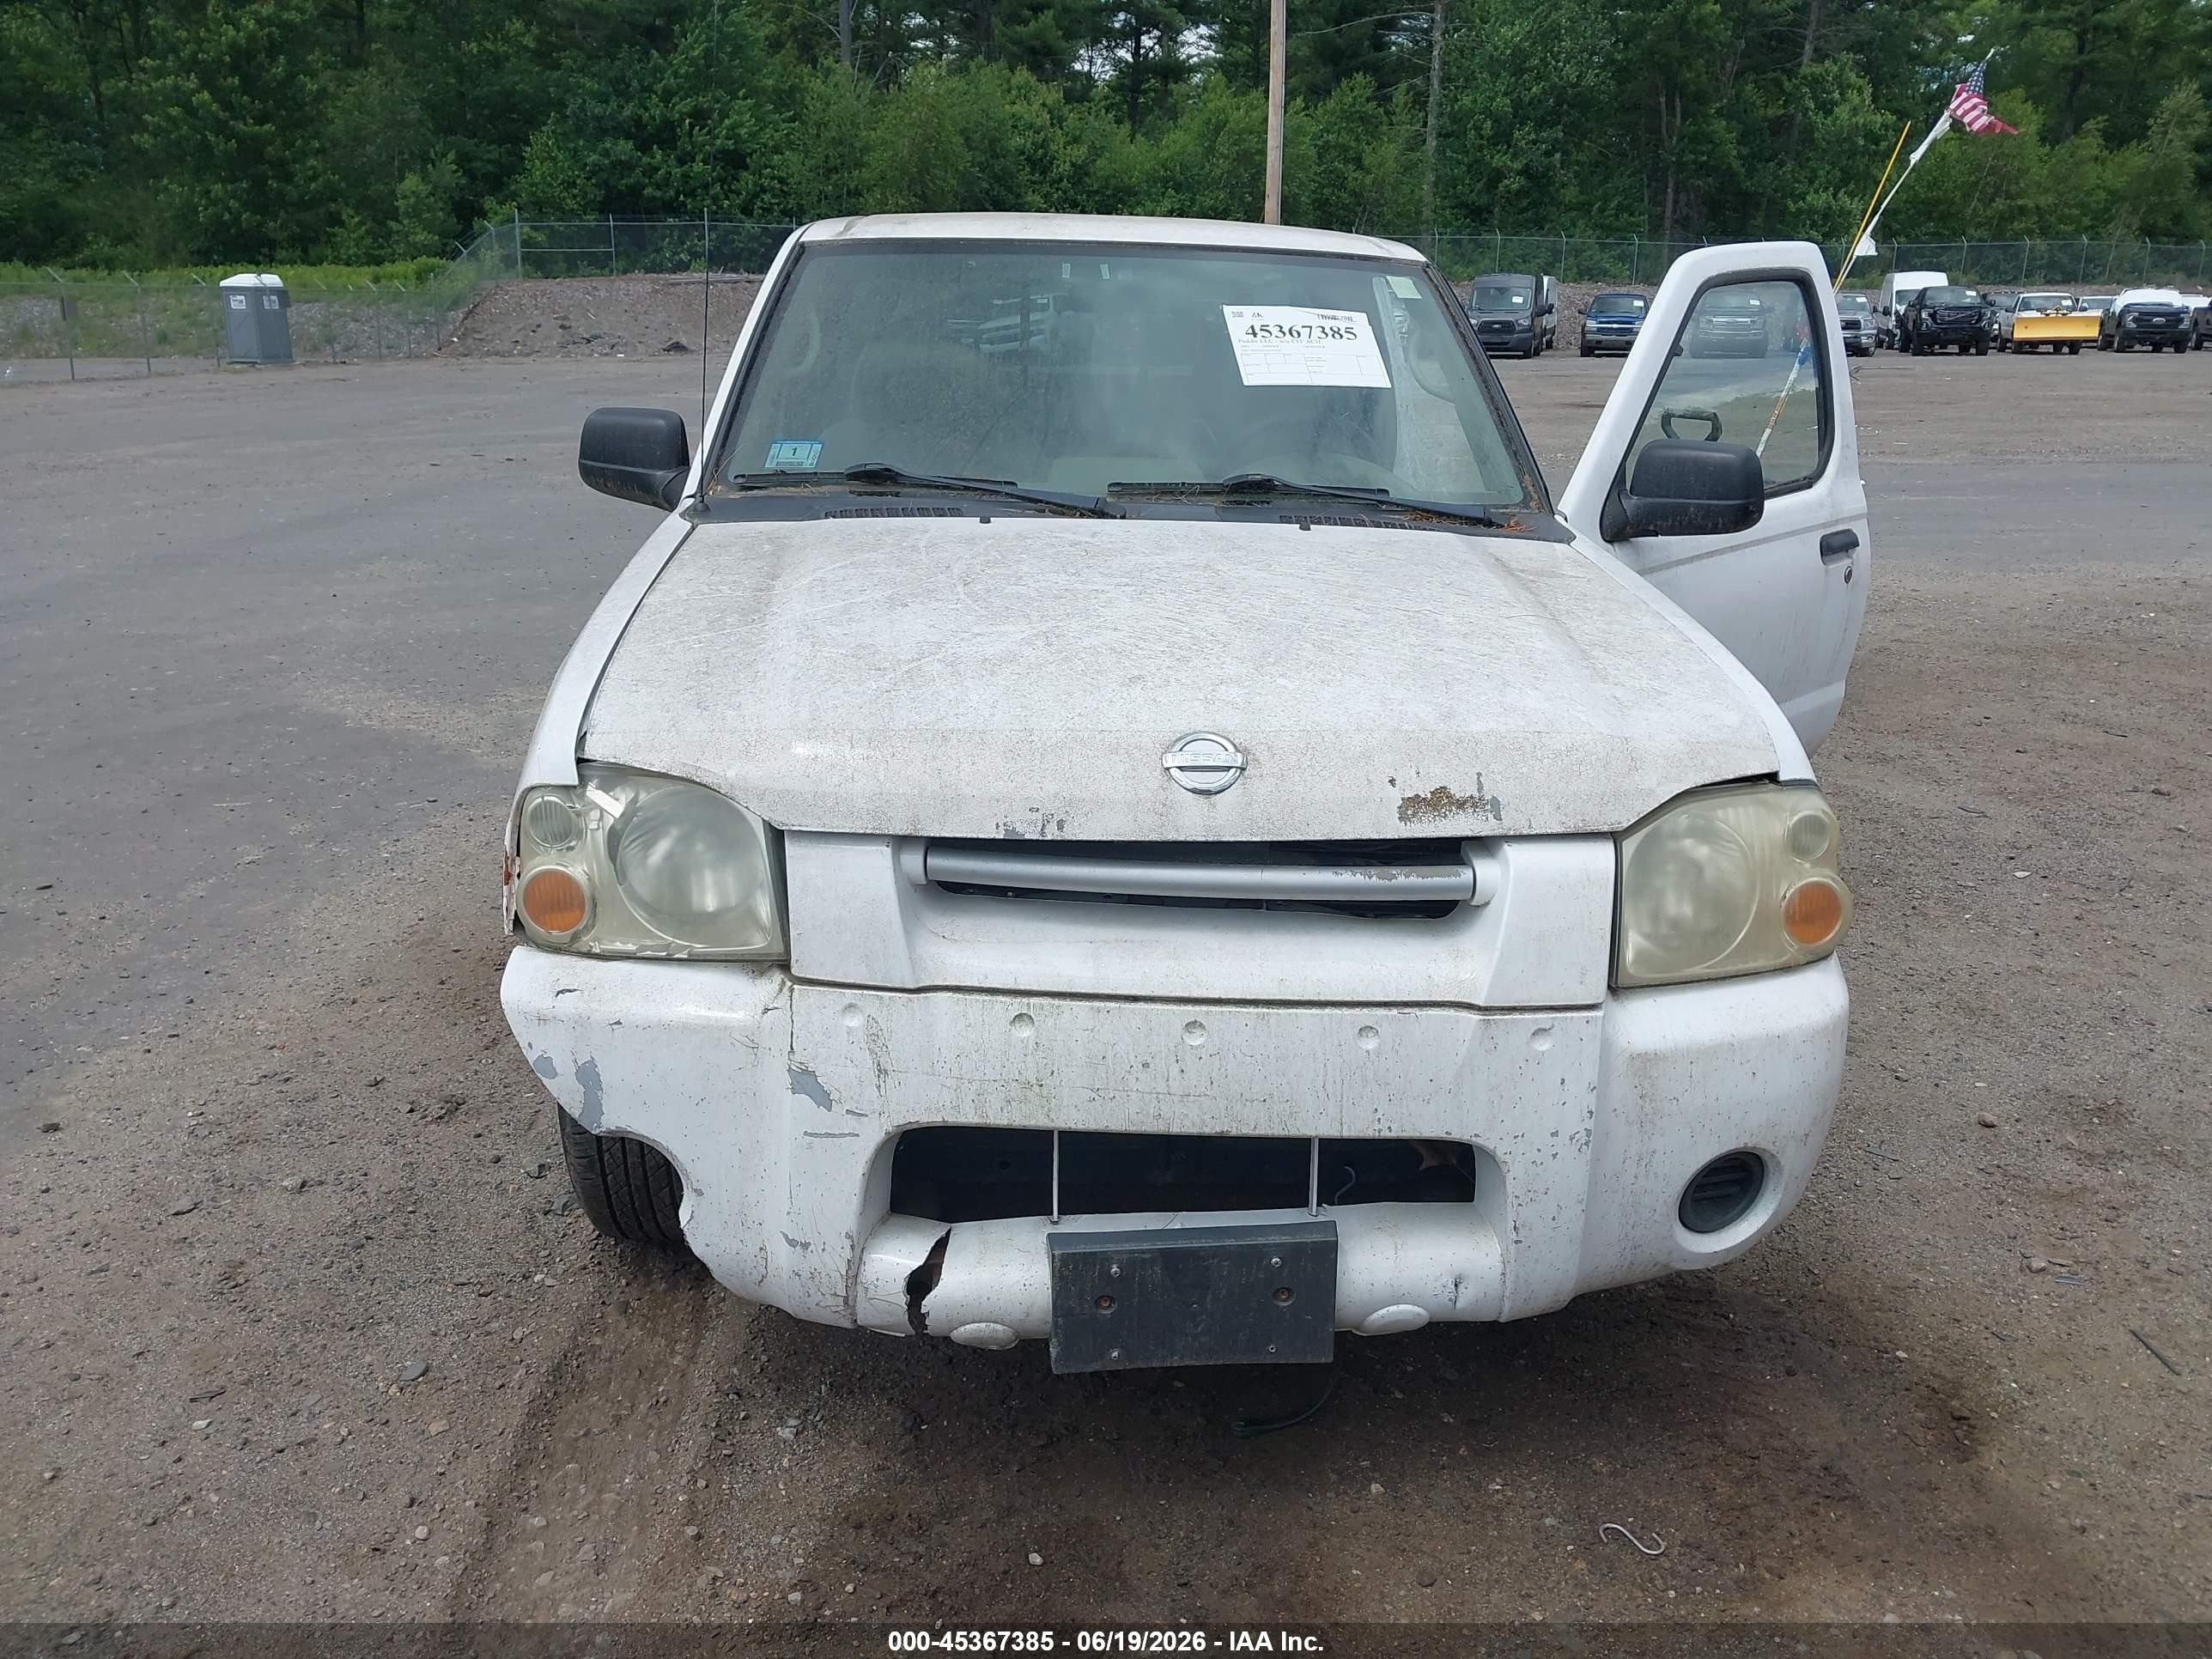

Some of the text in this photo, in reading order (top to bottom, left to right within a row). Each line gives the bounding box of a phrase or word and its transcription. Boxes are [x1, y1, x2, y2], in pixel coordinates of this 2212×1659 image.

[1245, 324, 1358, 340] 45367385
[792, 447, 798, 456] 1
[1164, 753, 1238, 764] NISSAN
